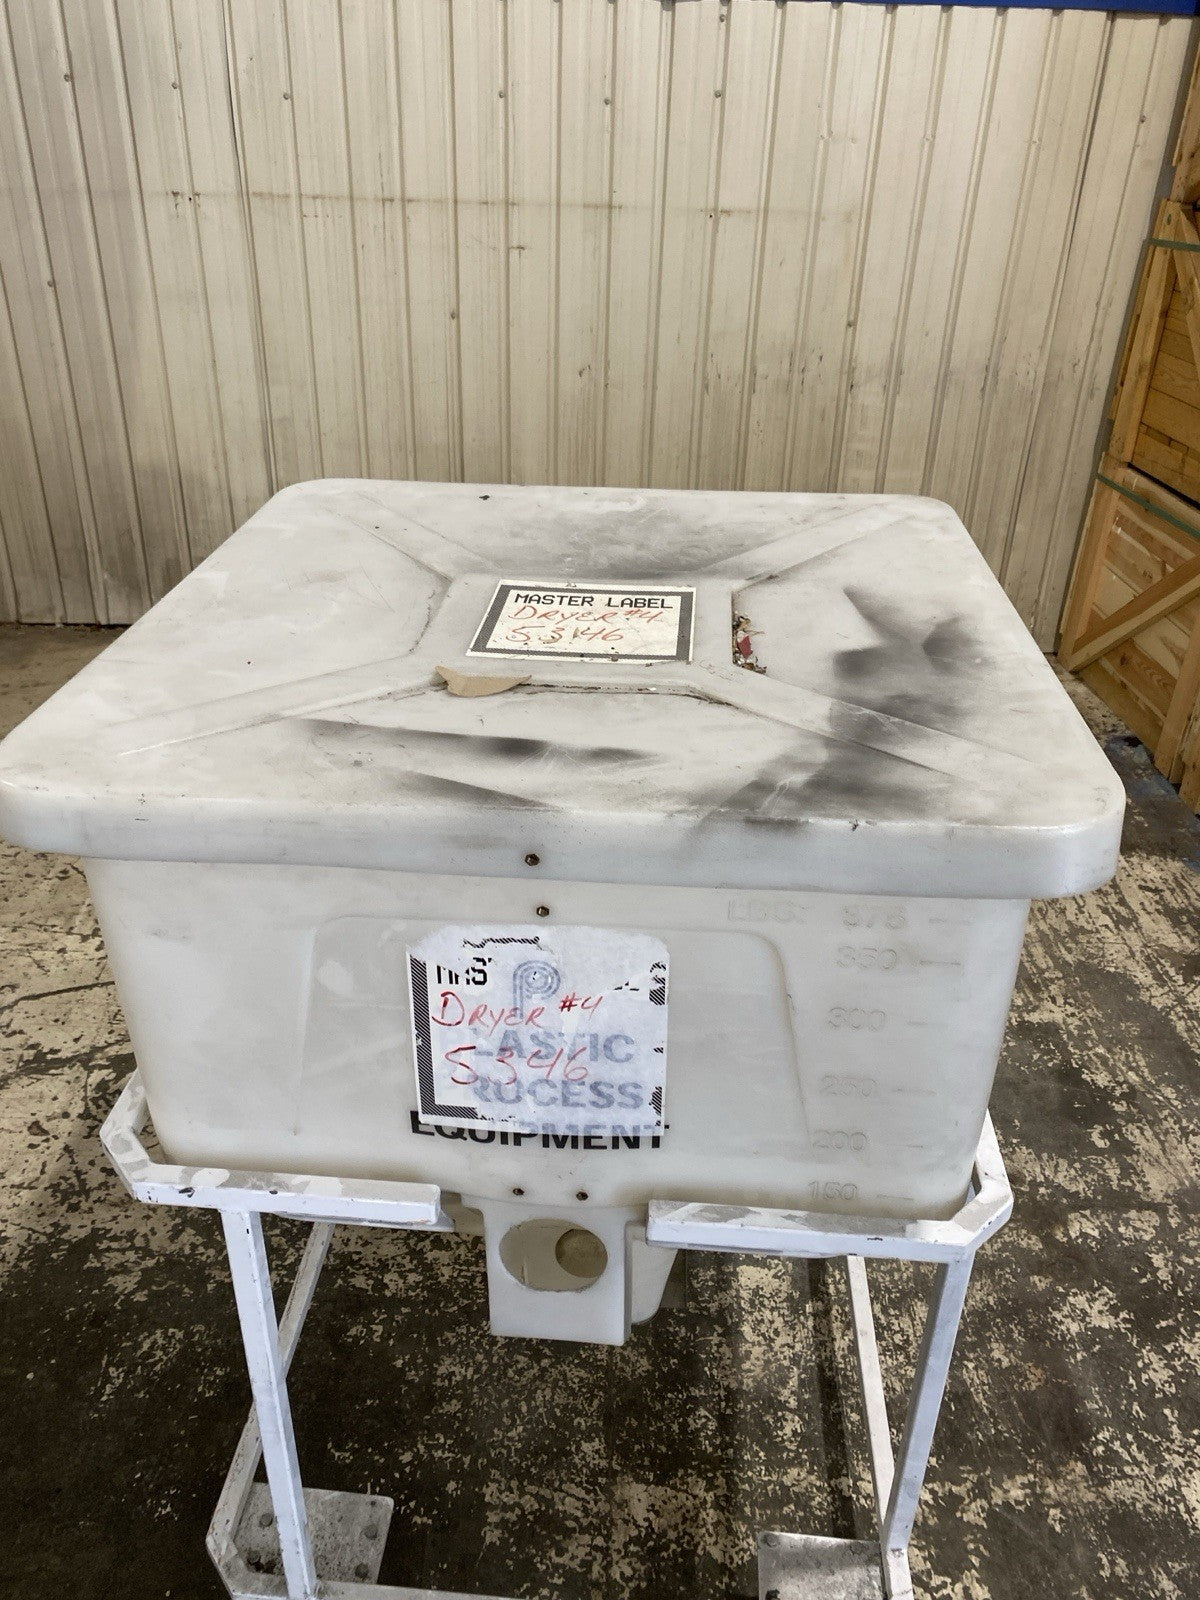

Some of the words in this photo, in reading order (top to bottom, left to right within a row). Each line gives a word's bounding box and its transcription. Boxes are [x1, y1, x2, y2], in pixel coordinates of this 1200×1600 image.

[514, 593, 595, 607] MASTER
[606, 597, 674, 609] LABEL
[622, 607, 664, 624] #4
[559, 991, 604, 1021] #4
[455, 1073, 644, 1110] ROCESS
[808, 1180, 858, 1202] 150
